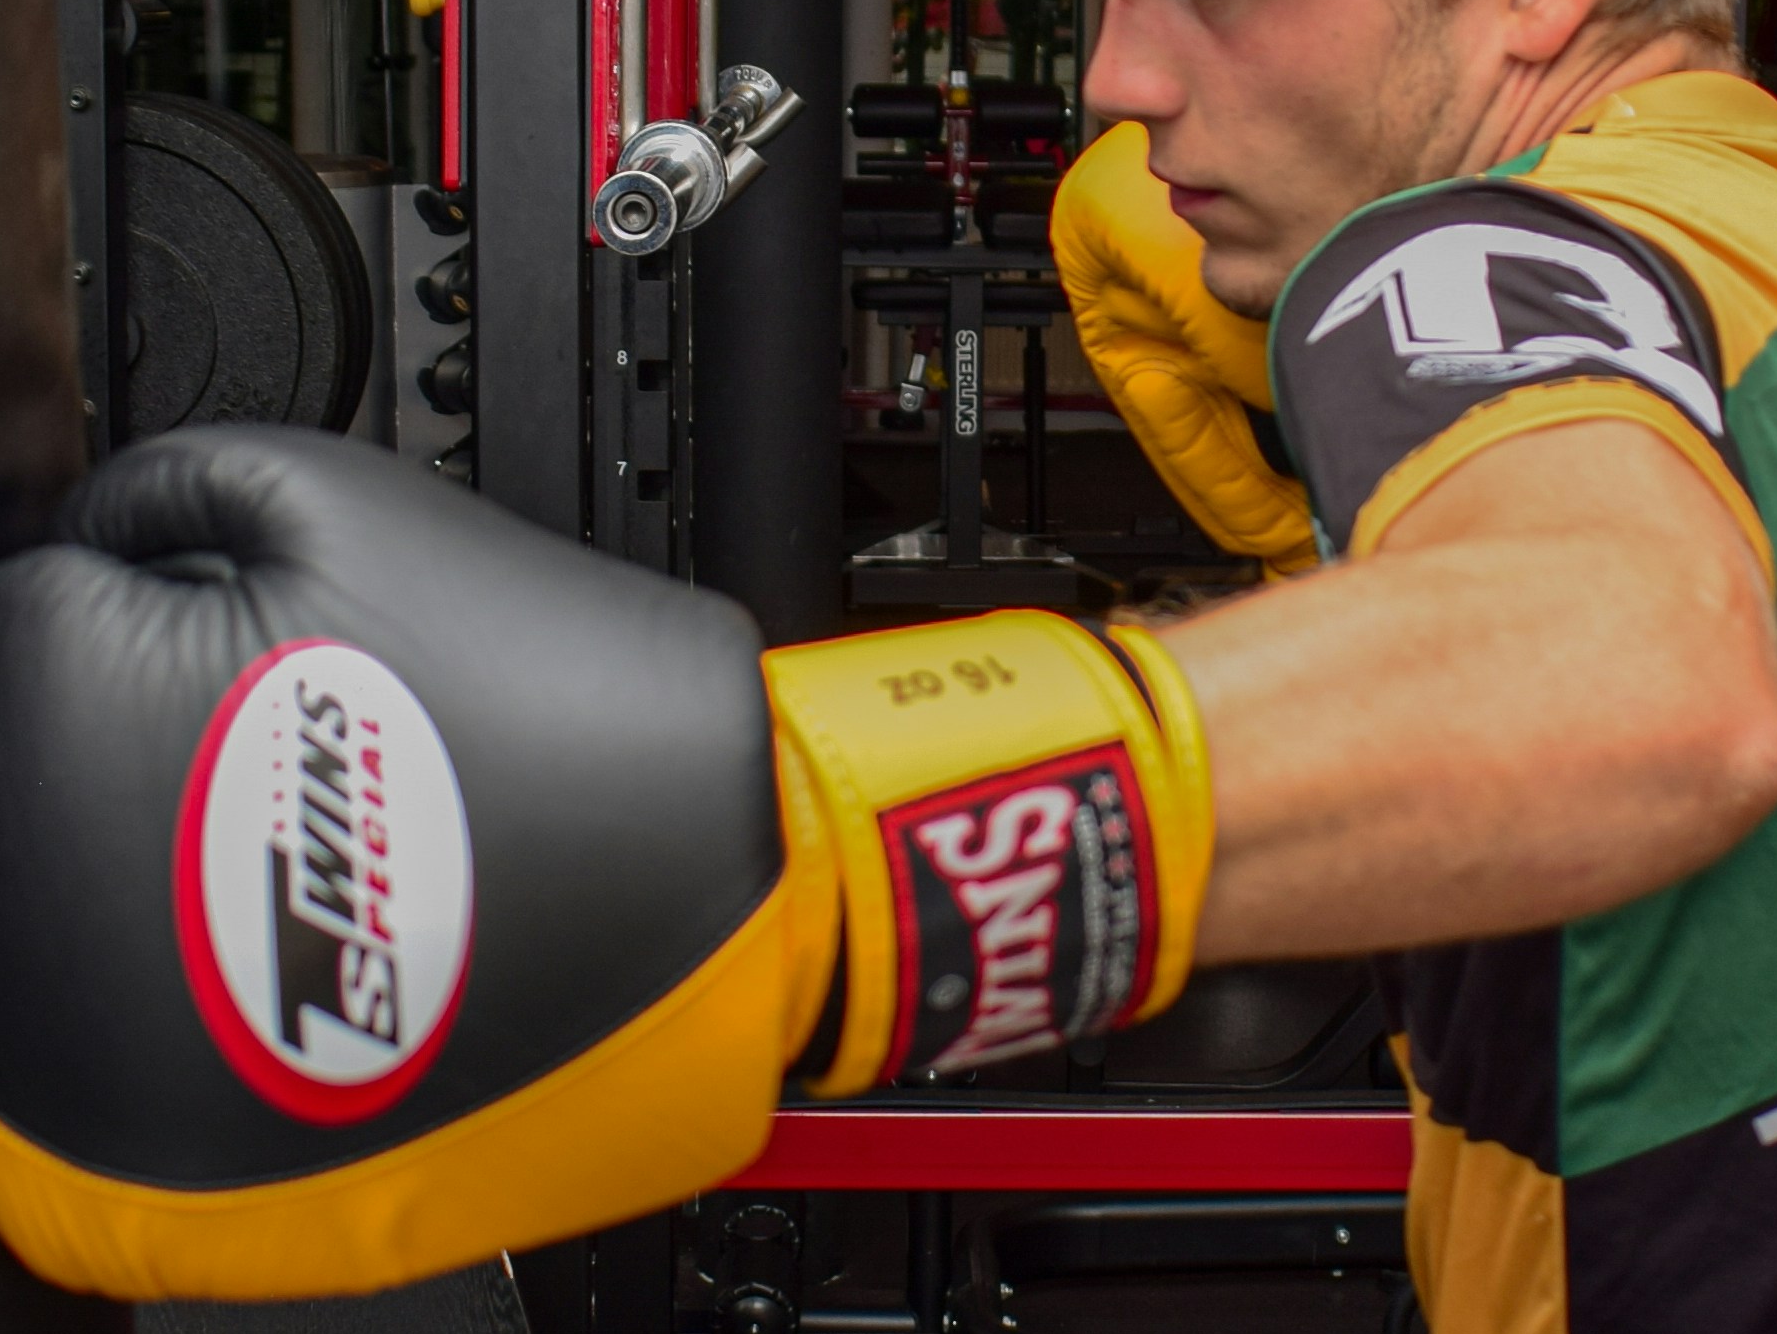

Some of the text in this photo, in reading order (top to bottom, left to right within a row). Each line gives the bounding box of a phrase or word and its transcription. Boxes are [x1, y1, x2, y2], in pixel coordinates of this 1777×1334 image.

[616, 350, 628, 365] 8
[955, 329, 979, 436] STERLING
[616, 461, 627, 476] 7
[952, 654, 1018, 695] 16
